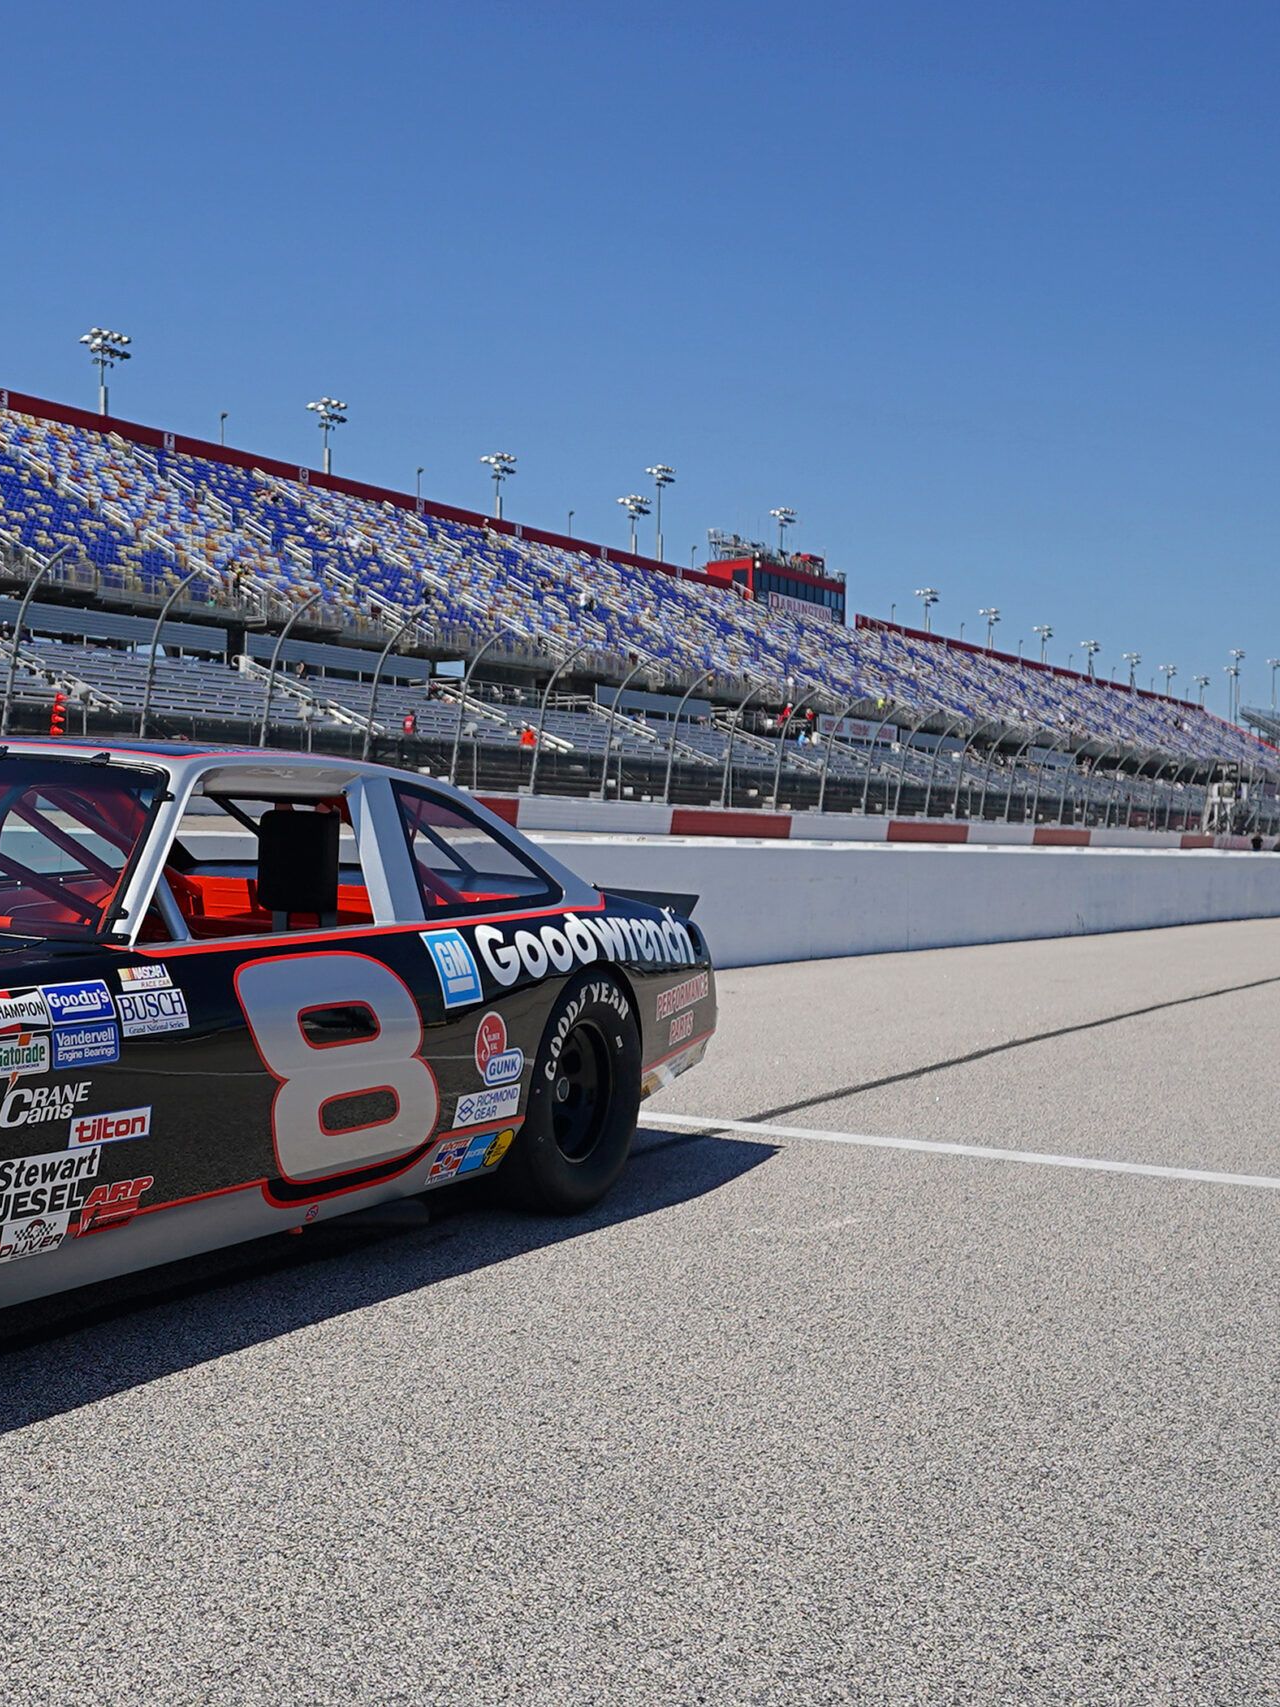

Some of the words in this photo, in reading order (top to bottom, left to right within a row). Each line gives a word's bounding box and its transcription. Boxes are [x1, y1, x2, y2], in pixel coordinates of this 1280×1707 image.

[0, 390, 5, 403] E
[770, 594, 832, 621] DARLINGTON
[435, 940, 471, 979] GM
[474, 909, 696, 987] Goodwrench
[132, 964, 166, 979] NASCAR
[47, 987, 110, 1013] Goody's
[117, 992, 187, 1022] BUSCH
[56, 1027, 115, 1046] Vandervell
[669, 1010, 694, 1046] PARTS
[58, 1050, 83, 1062] Engine
[84, 1046, 115, 1057] Bearings
[234, 951, 439, 1185] 8
[488, 1058, 518, 1077] GUNK
[476, 1088, 519, 1106] RICHMOND
[474, 1105, 497, 1120] GEAR
[75, 1115, 146, 1143] tilton
[82, 1175, 154, 1209] ARP
